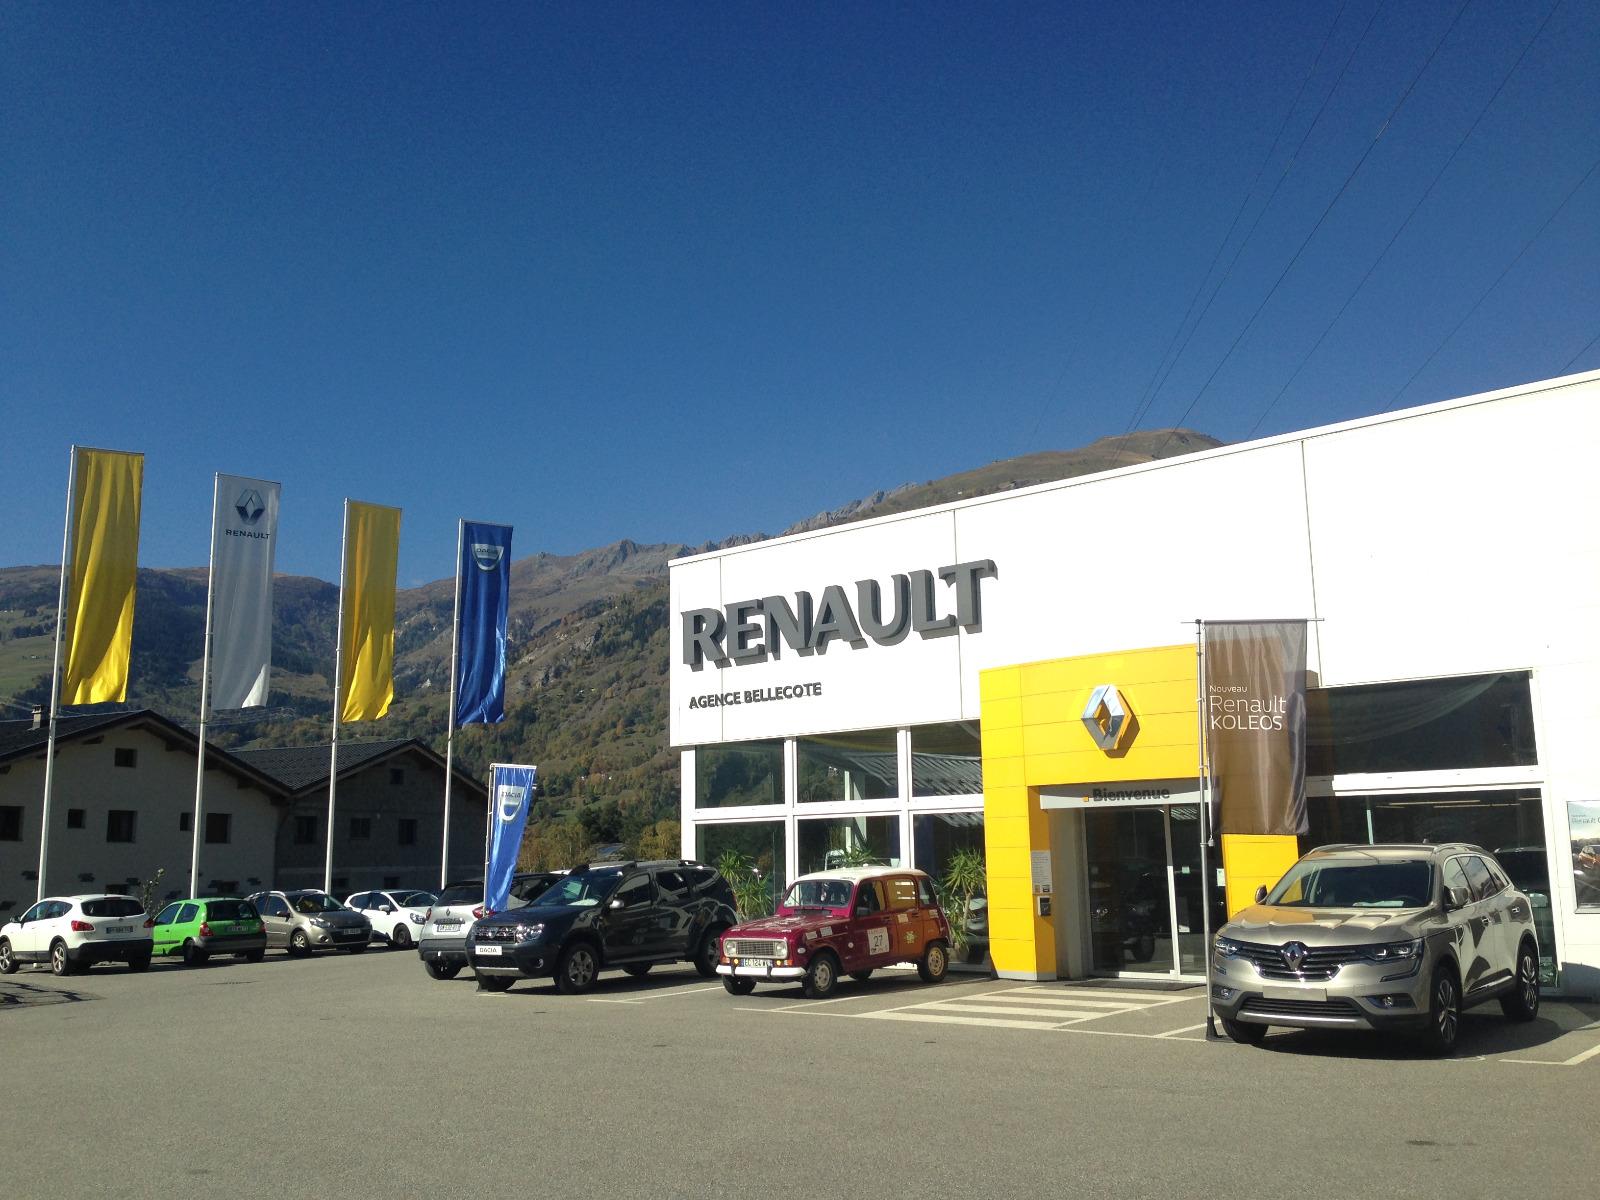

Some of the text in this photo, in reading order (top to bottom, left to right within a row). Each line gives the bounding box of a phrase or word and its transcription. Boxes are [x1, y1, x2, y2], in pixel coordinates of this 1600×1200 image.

[225, 529, 271, 539] RENAULT
[680, 558, 998, 672] RENAULT
[689, 682, 822, 709] AGENCE BELLECOTE
[1209, 685, 1248, 693] Nouveau
[1209, 695, 1287, 714] Renault
[1210, 715, 1283, 731] KOLEOS
[1092, 788, 1170, 802] Bienvenue
[873, 934, 883, 947] 27
